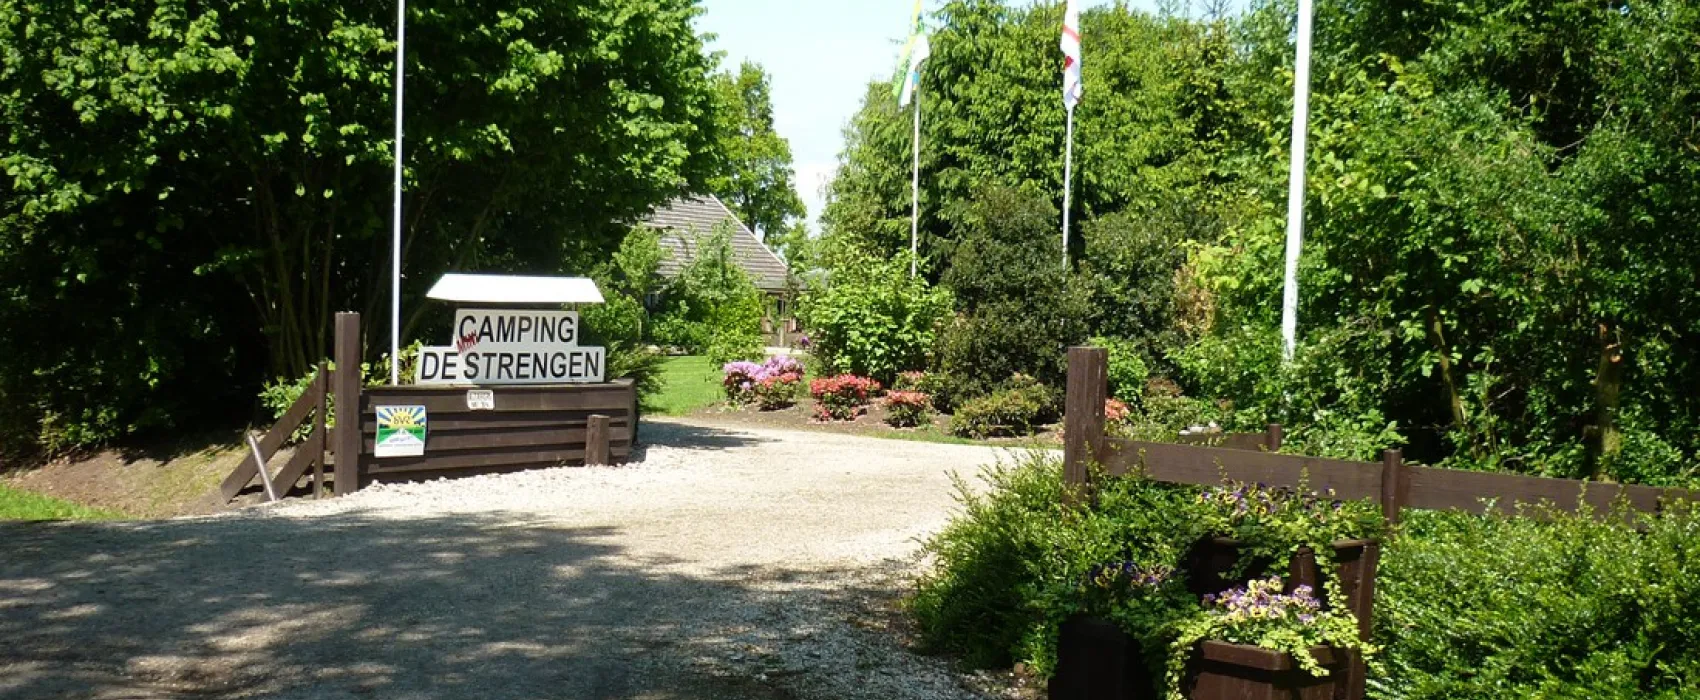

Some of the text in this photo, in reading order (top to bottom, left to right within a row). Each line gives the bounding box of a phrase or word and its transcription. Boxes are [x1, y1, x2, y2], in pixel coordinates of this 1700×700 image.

[458, 315, 574, 343] CAMPING
[421, 352, 599, 380] DE STRENGEN
